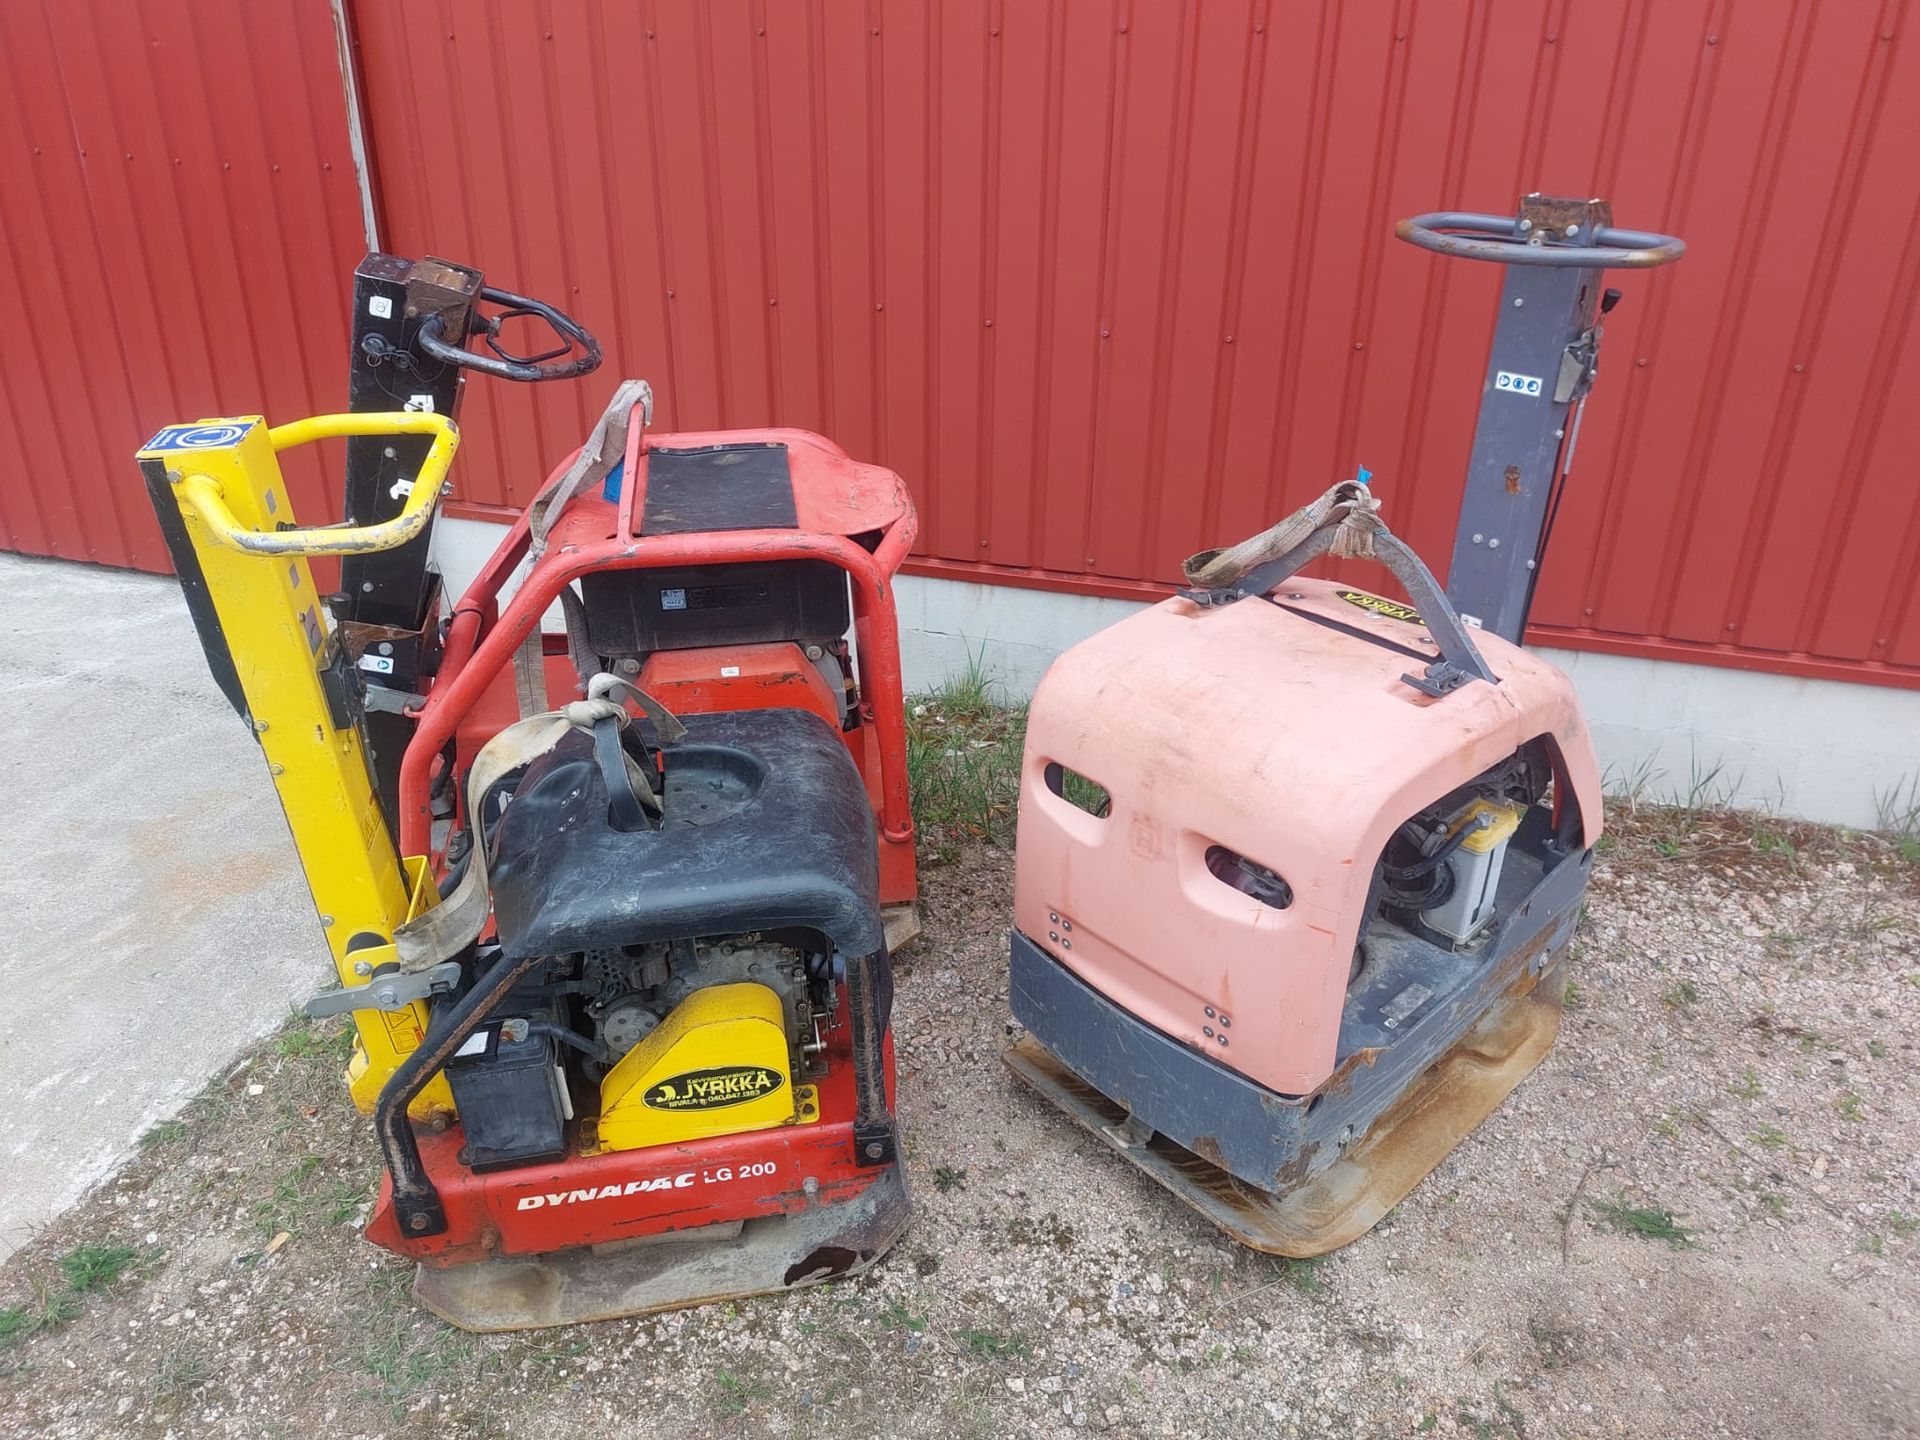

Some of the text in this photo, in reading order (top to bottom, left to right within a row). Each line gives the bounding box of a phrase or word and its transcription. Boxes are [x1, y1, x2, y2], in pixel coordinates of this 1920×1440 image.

[517, 1161, 777, 1211] DYNAPAC LG 200
